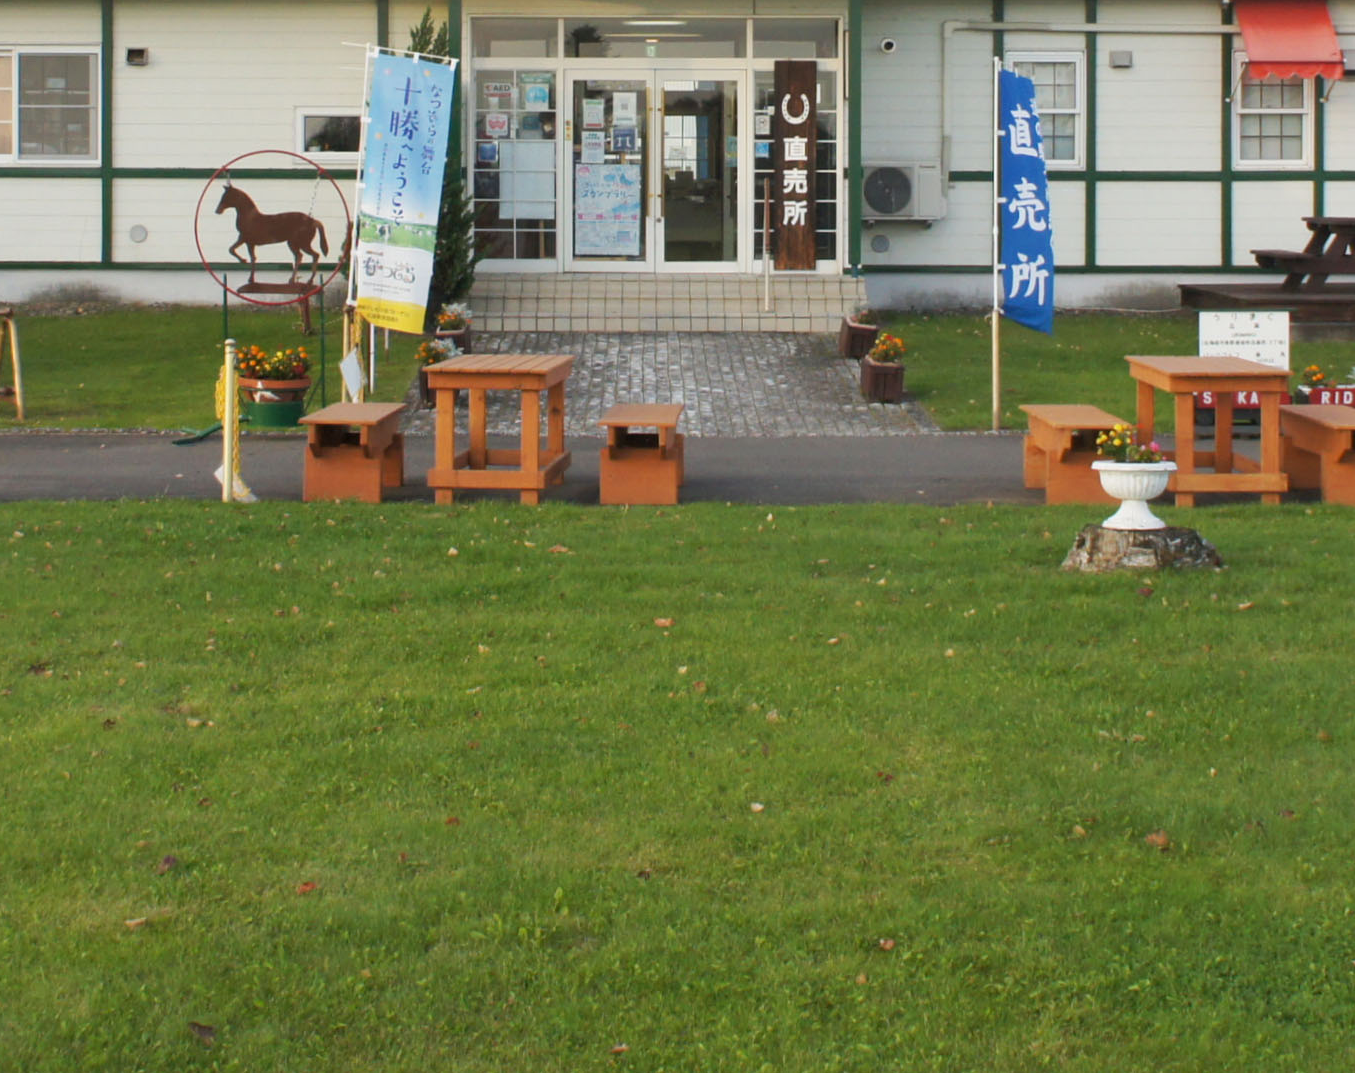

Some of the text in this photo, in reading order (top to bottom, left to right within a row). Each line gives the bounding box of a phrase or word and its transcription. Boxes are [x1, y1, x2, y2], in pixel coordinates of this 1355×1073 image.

[389, 77, 422, 226] 十勝へようこそ
[782, 135, 809, 226] 直売所
[1007, 104, 1049, 306] 直売所
